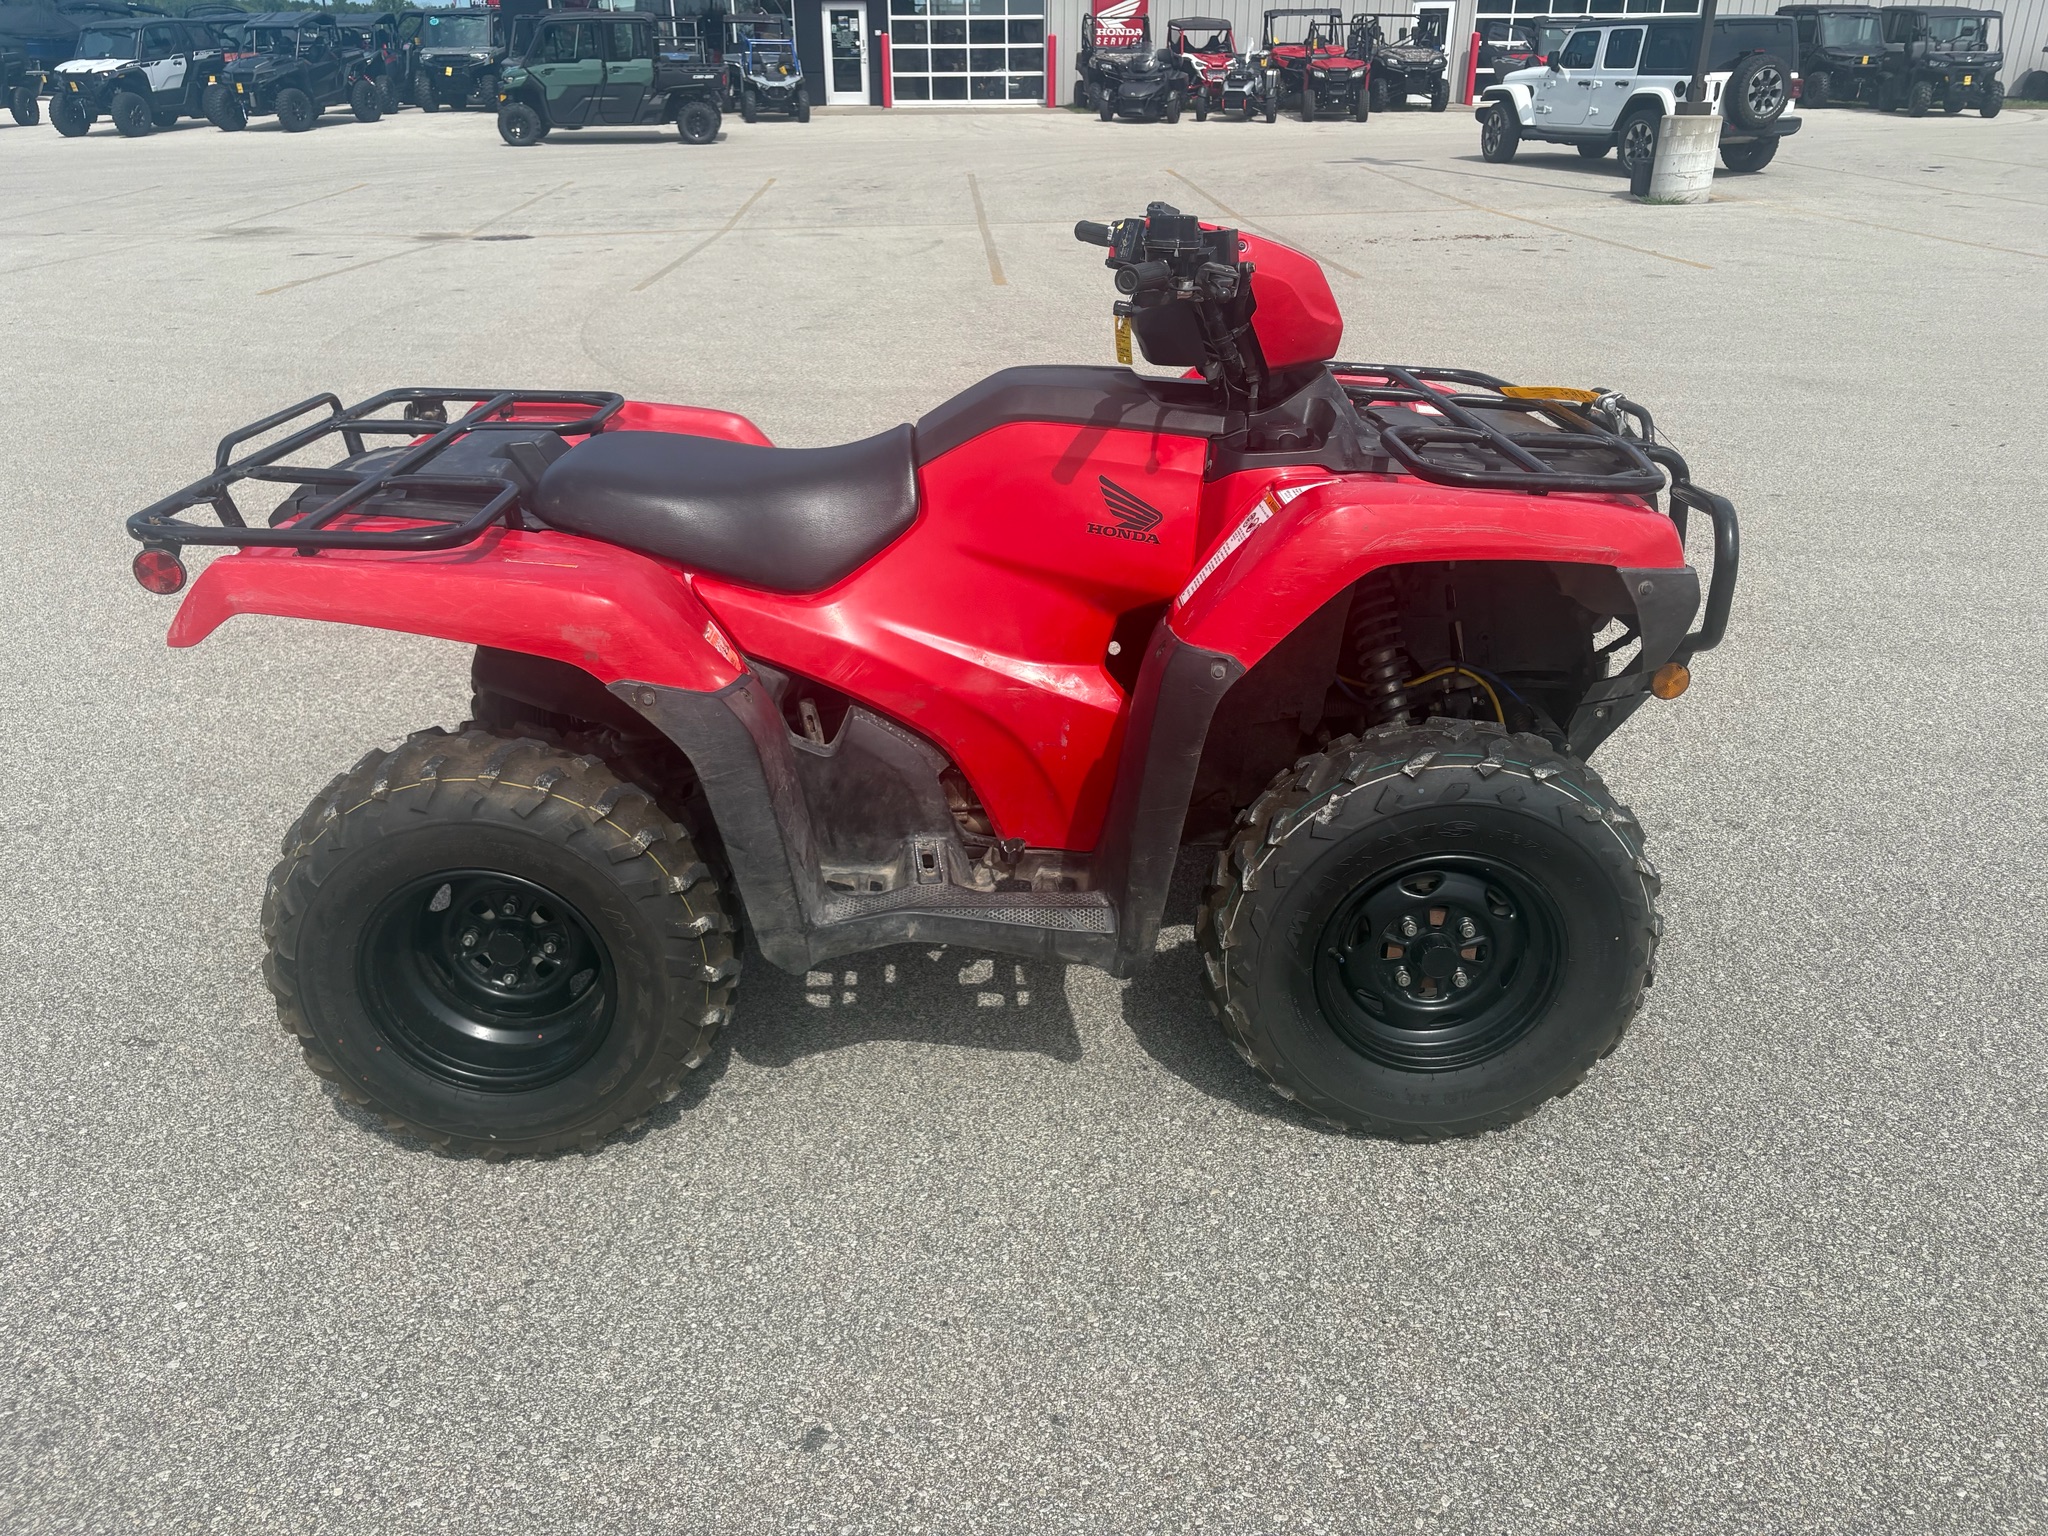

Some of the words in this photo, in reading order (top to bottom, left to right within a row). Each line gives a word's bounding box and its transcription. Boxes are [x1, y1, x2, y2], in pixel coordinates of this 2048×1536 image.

[1096, 28, 1143, 36] HONDA
[1096, 37, 1143, 46] SERVIC
[1087, 523, 1160, 545] HONDA
